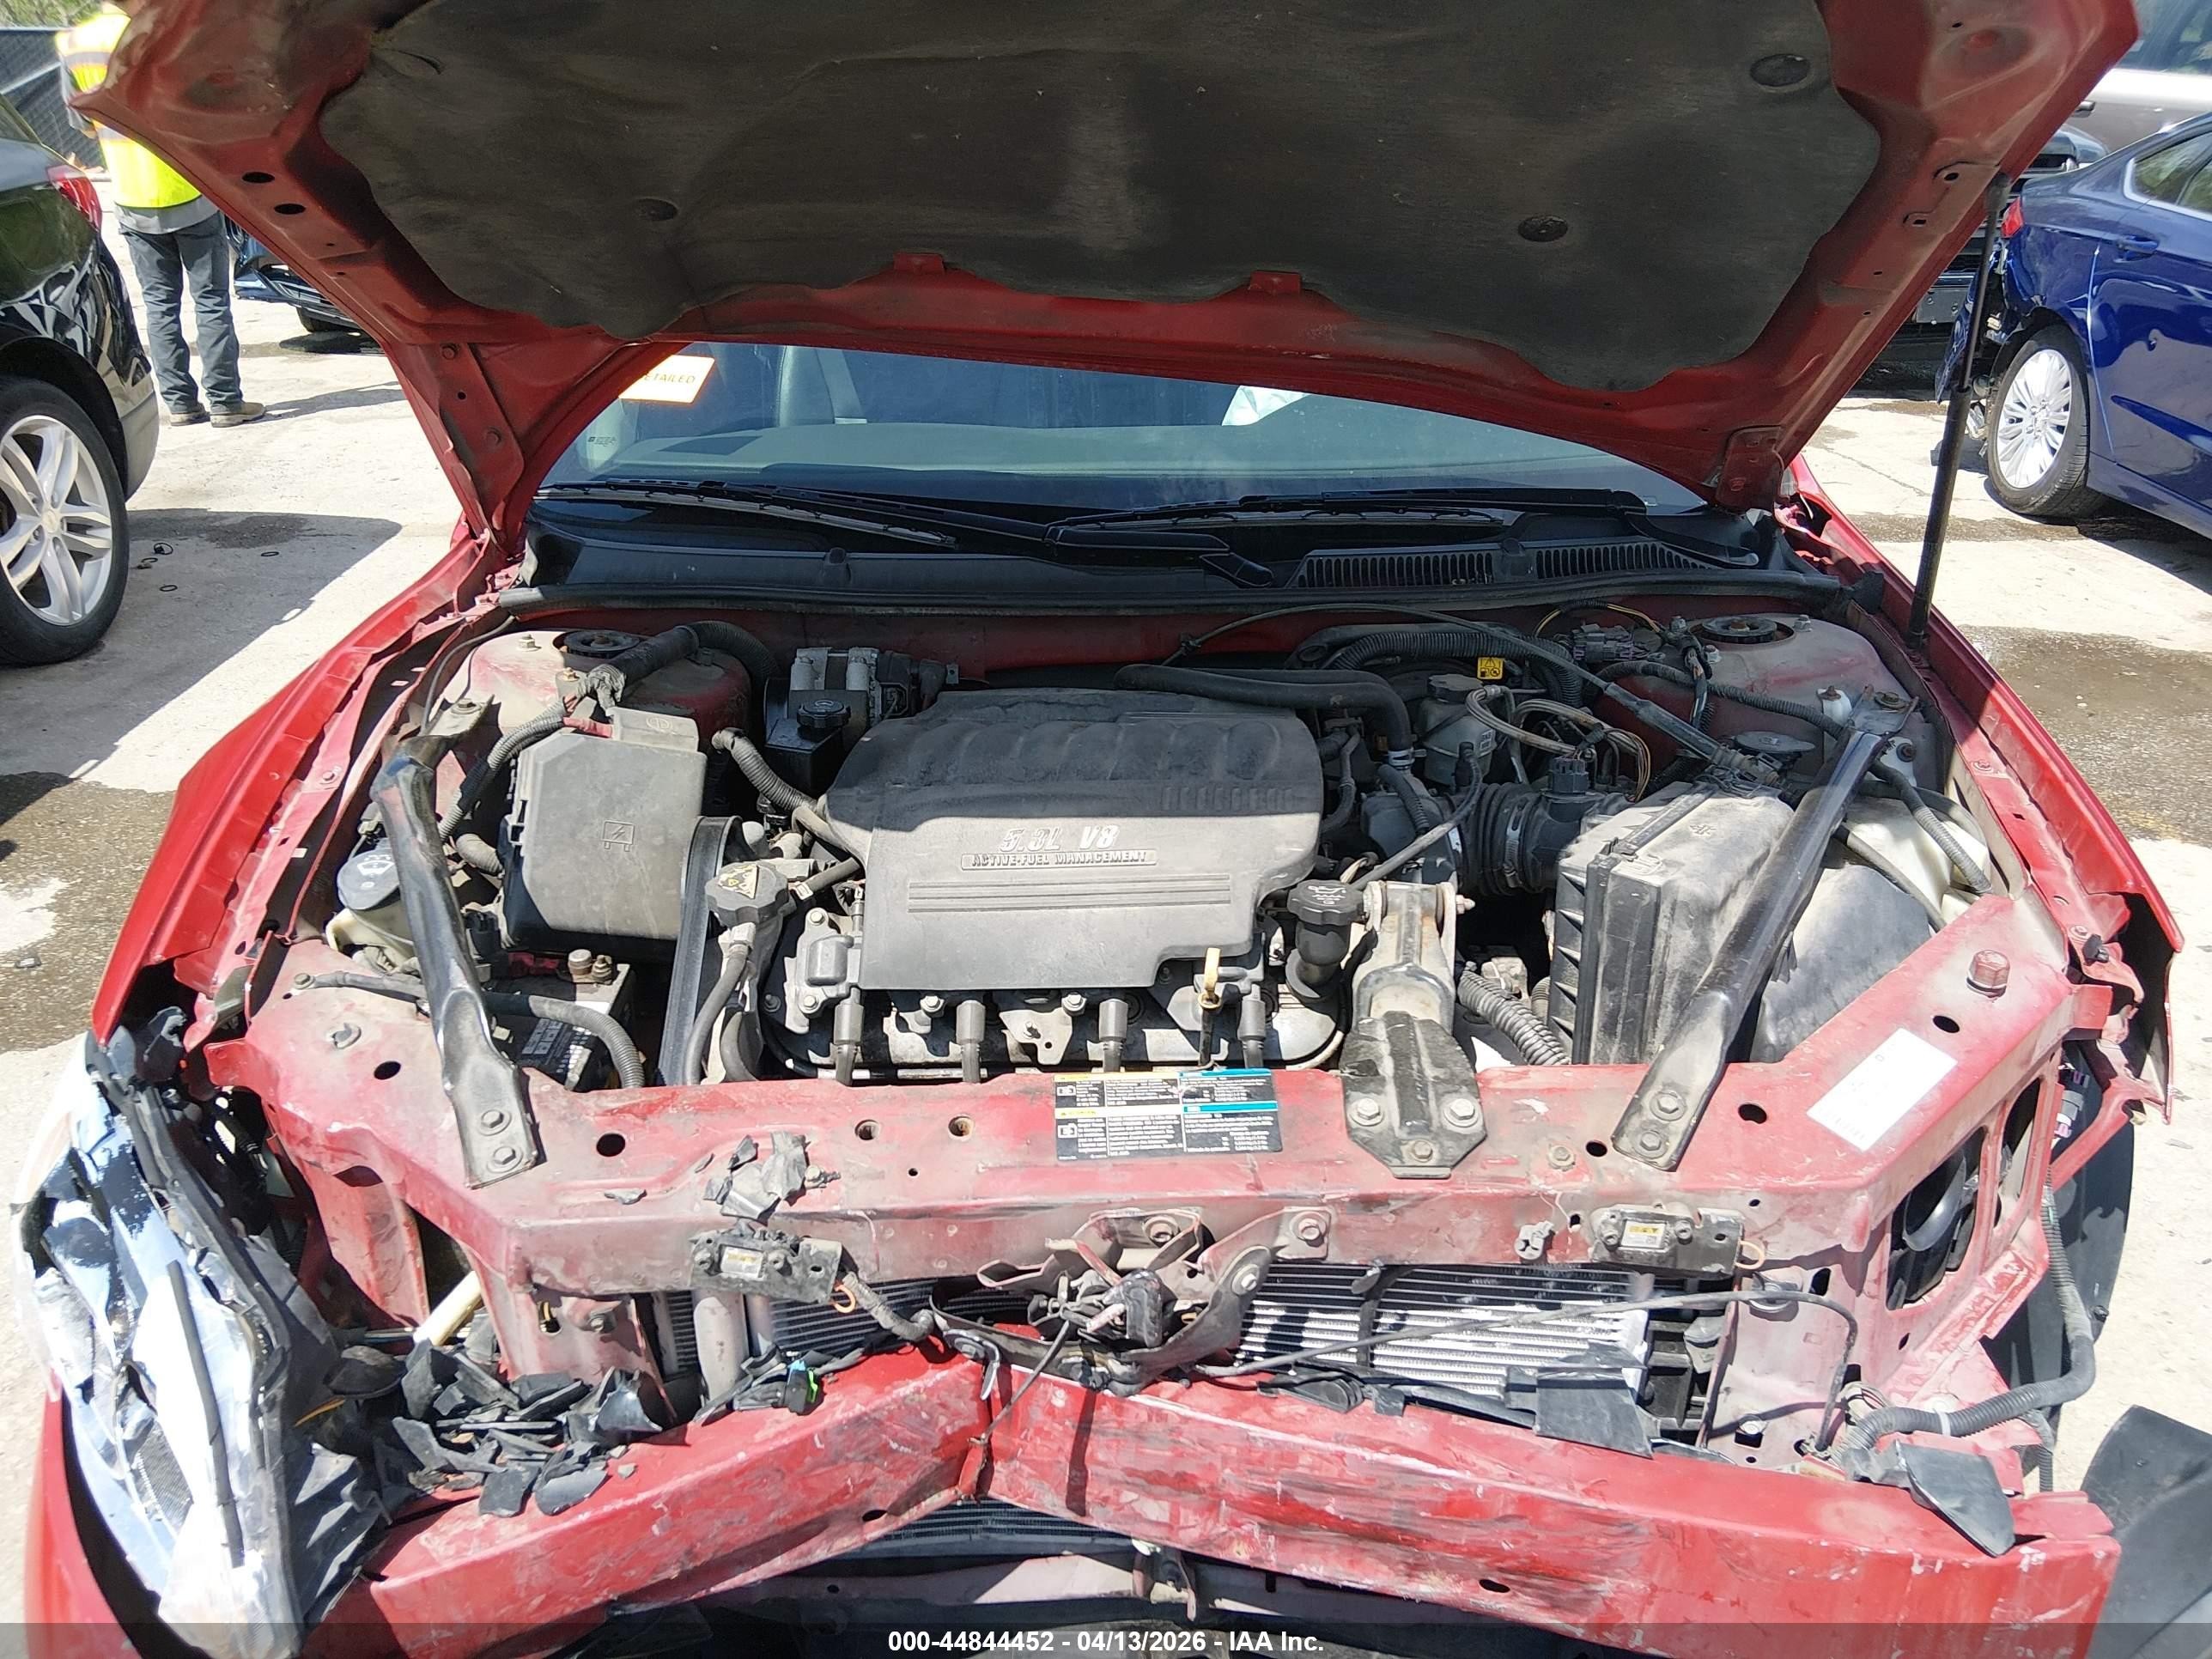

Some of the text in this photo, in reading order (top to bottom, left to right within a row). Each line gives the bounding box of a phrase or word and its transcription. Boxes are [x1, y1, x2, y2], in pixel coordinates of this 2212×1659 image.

[1000, 824, 1120, 852] 5.3L V8
[1054, 850, 1147, 866] MANAGEMENT
